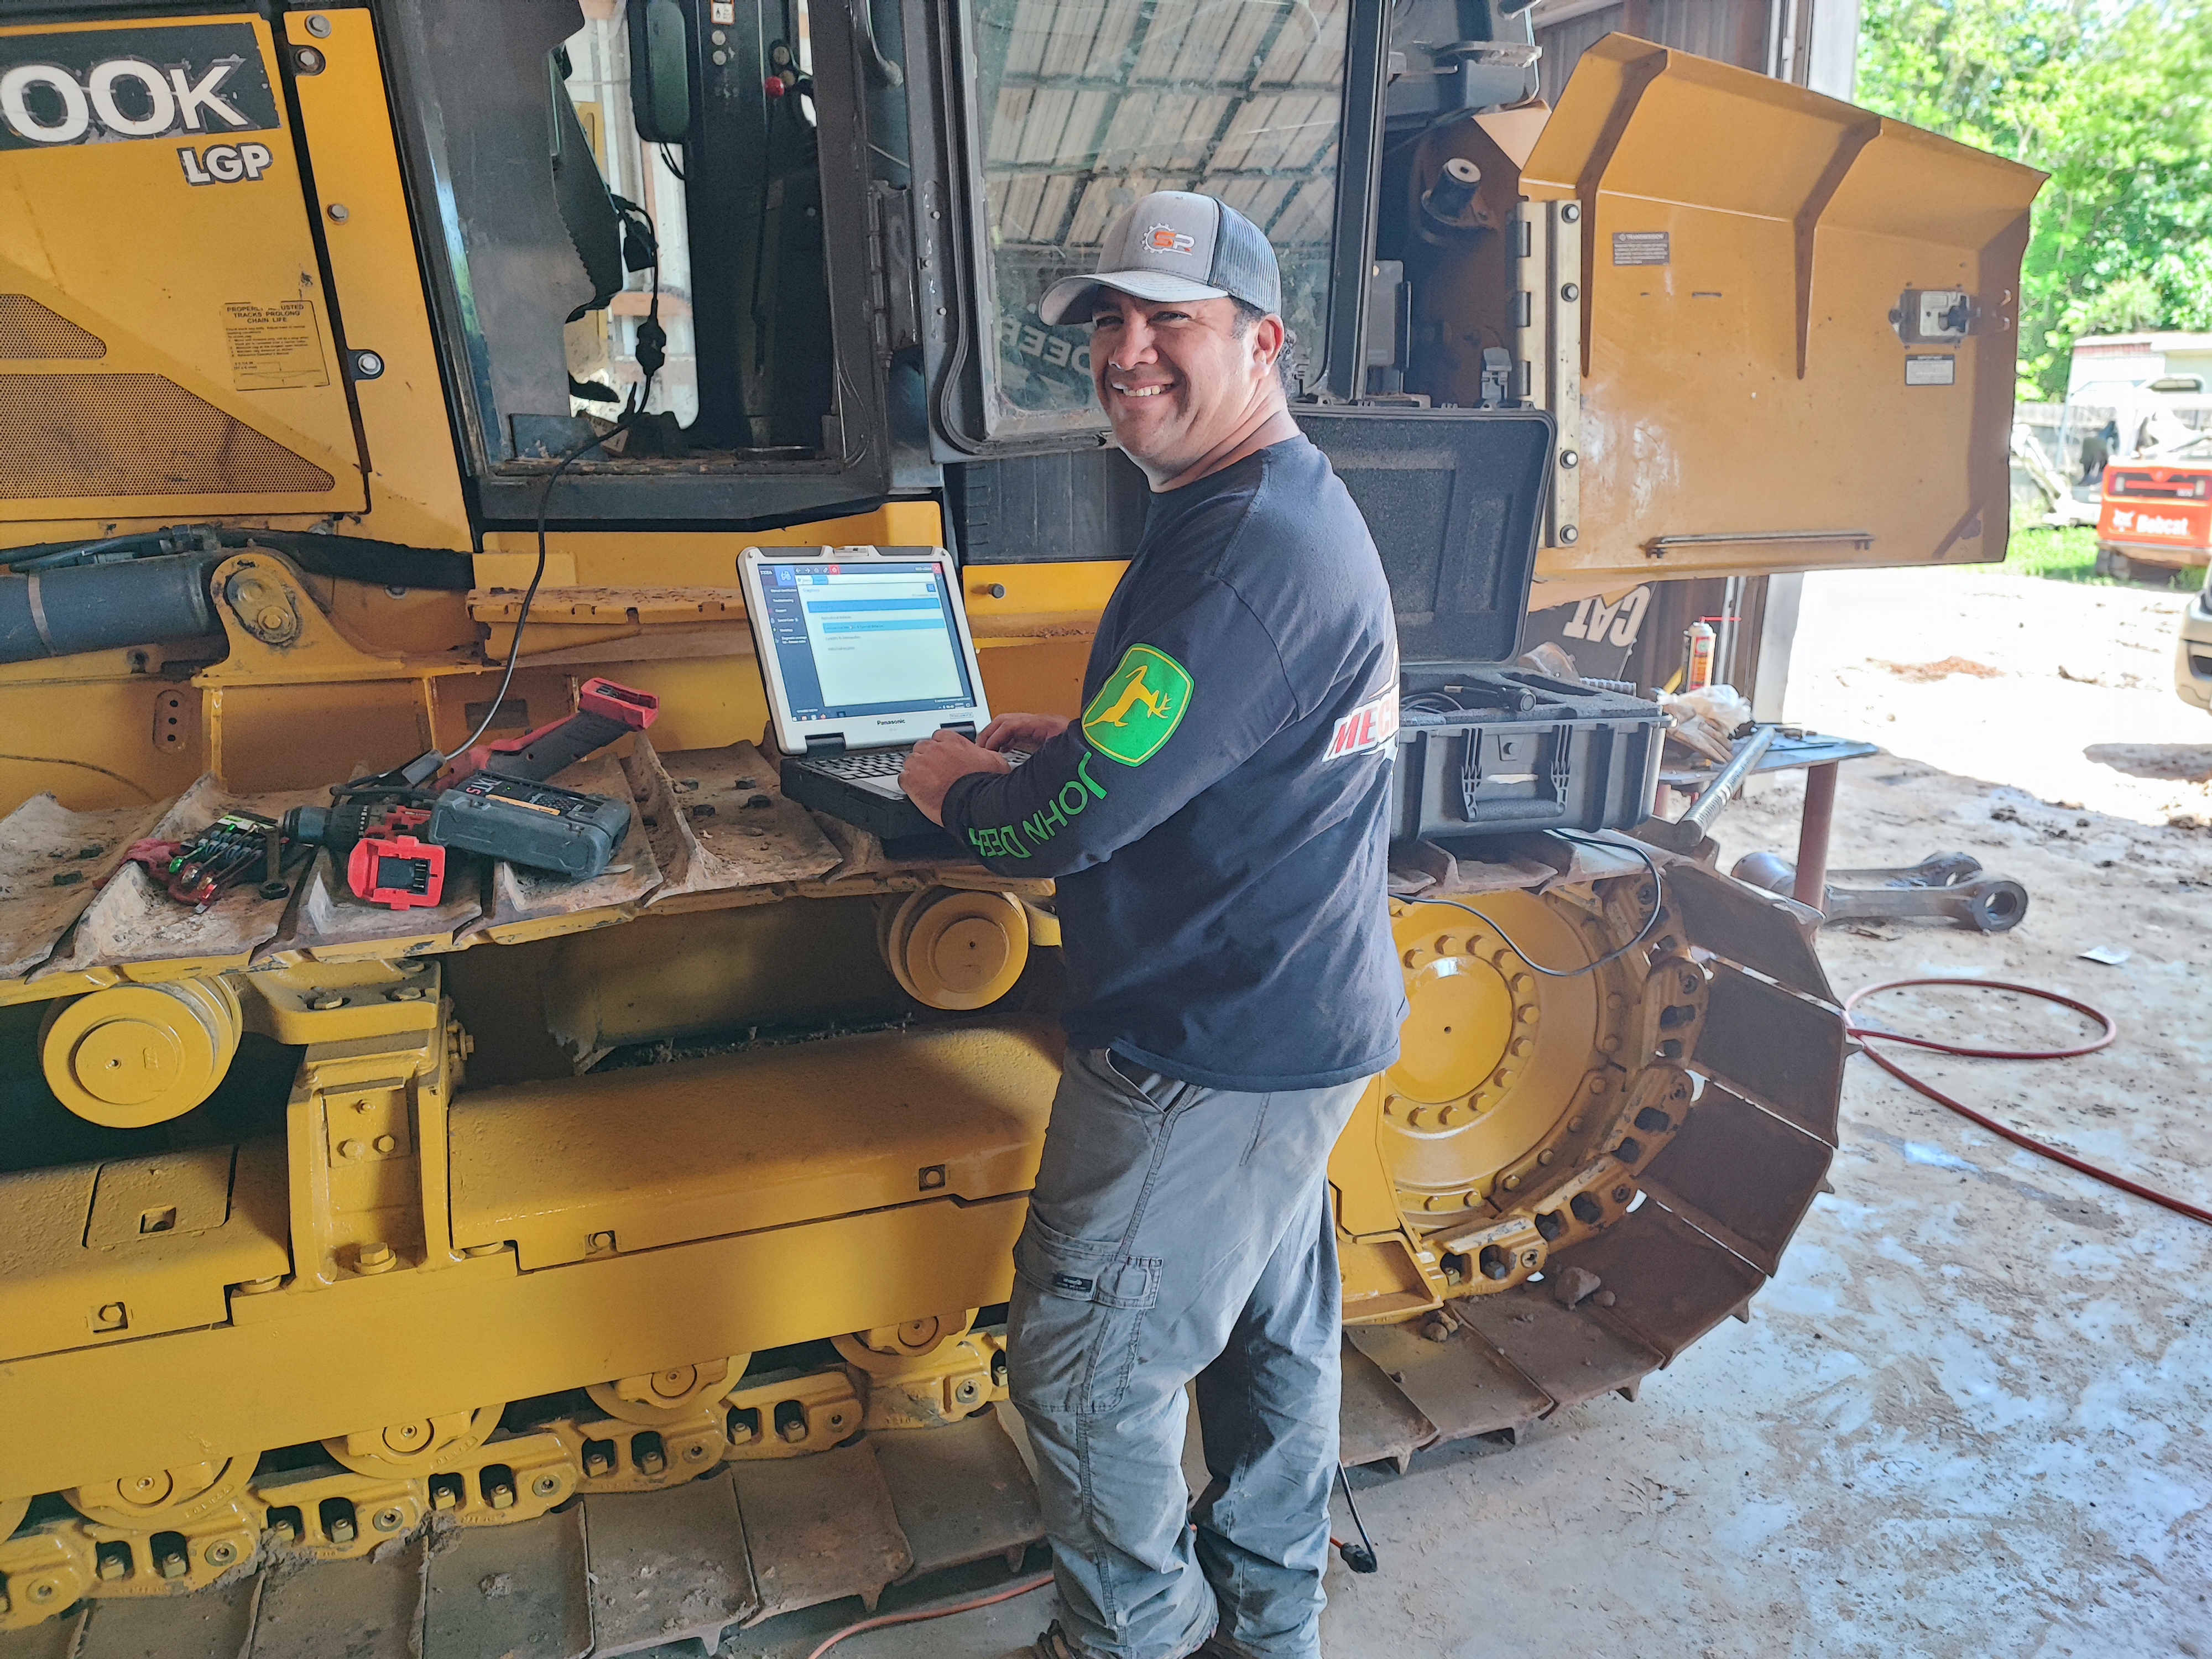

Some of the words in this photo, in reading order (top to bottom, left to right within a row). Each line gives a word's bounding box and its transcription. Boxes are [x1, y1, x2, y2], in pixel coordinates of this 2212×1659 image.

[180, 144, 272, 184] LGP
[1562, 585, 1651, 648] CAT
[1022, 751, 1108, 845] JOHN
